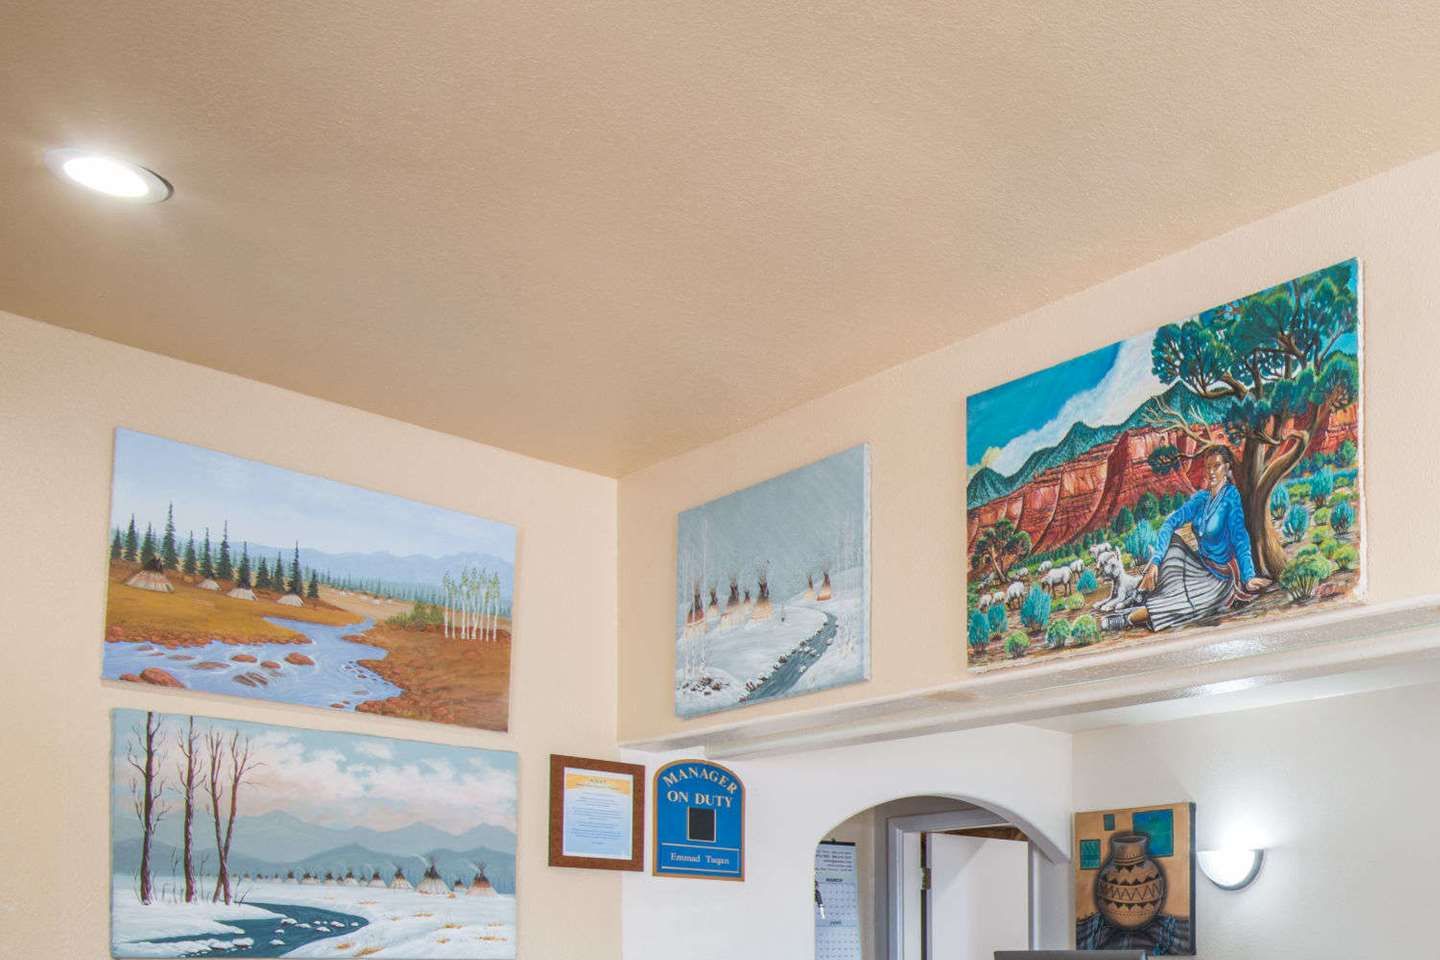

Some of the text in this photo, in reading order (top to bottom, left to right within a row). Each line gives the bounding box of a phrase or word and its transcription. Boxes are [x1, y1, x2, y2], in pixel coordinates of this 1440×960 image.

[662, 767, 738, 794] MANAGER
[667, 790, 734, 808] ON DUTY
